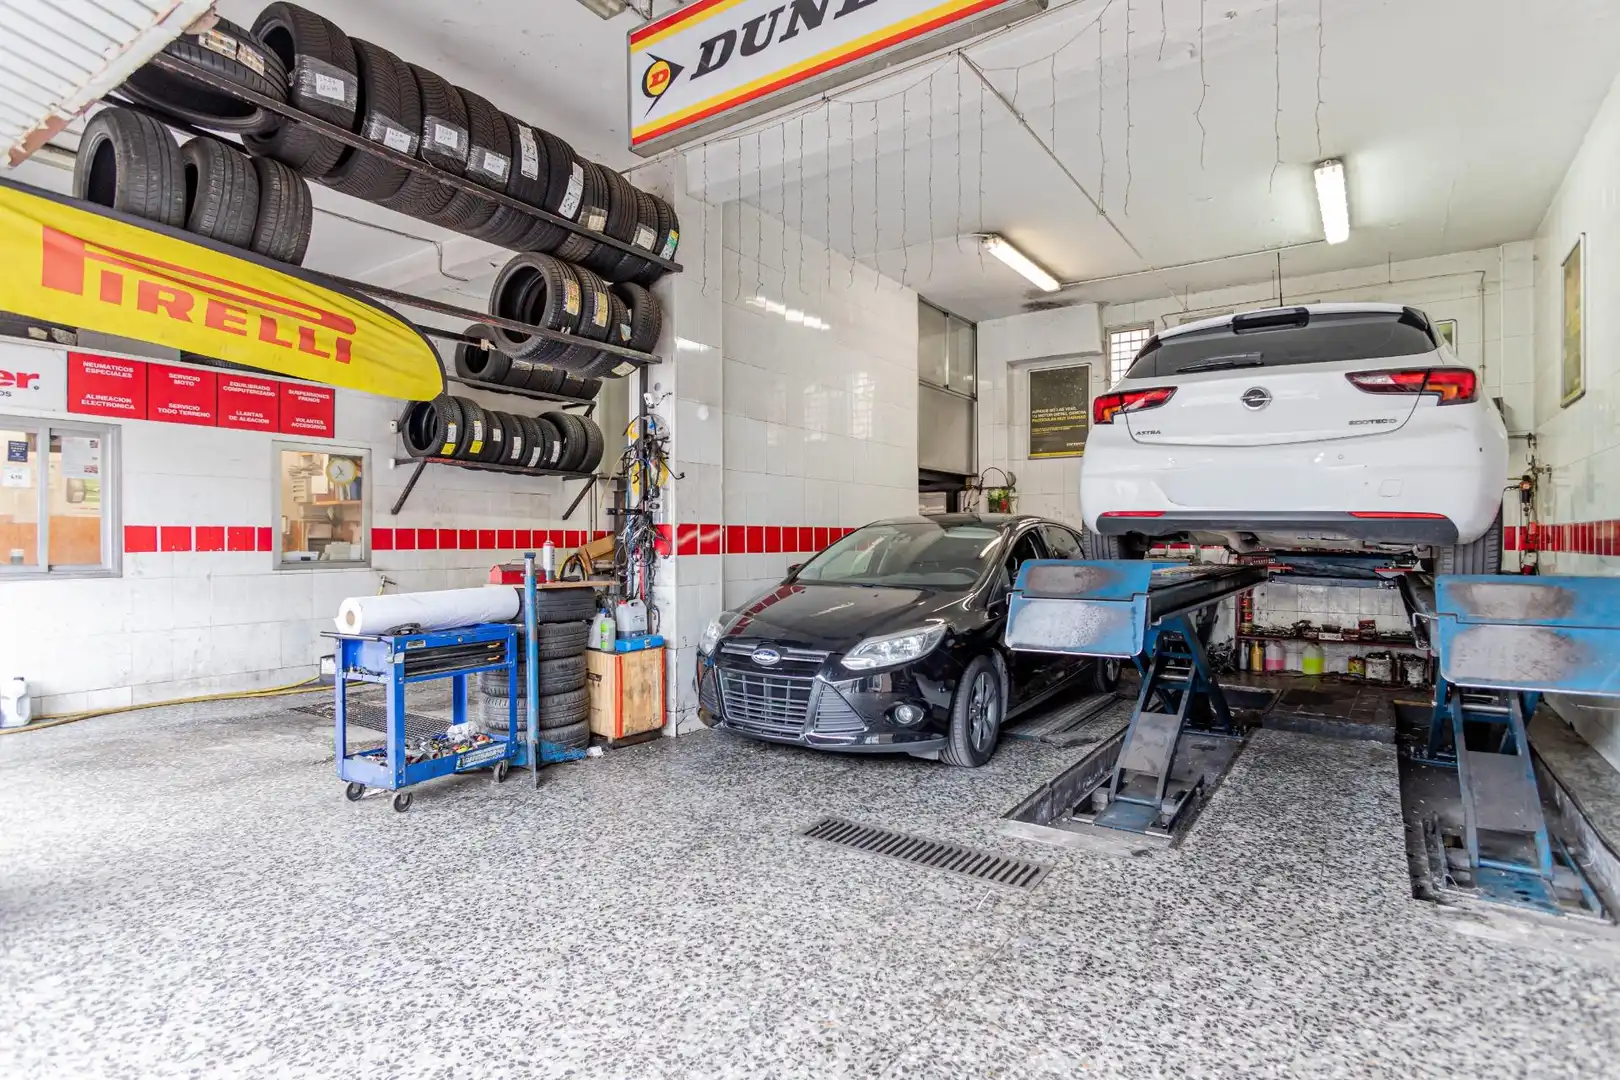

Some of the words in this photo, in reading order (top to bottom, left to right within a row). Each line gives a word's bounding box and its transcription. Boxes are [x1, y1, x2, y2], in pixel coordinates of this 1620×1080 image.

[42, 225, 357, 365] PIRELLI
[82, 360, 135, 374] NEUMATICOS
[84, 367, 133, 379] ESPECIALES
[168, 372, 201, 383] SERVICIO
[173, 379, 195, 387] MOTO
[229, 381, 271, 392] EQUILIBRADO
[85, 393, 132, 404] ALINEACION
[288, 389, 330, 400] SUSPENSIONES
[80, 399, 136, 410] ELECTRONICA
[168, 402, 201, 412] SERVICIO
[157, 407, 178, 415] TODO
[179, 409, 211, 418] TERRENO
[235, 410, 264, 419] LLANTAS
[239, 416, 270, 425] ALEACION
